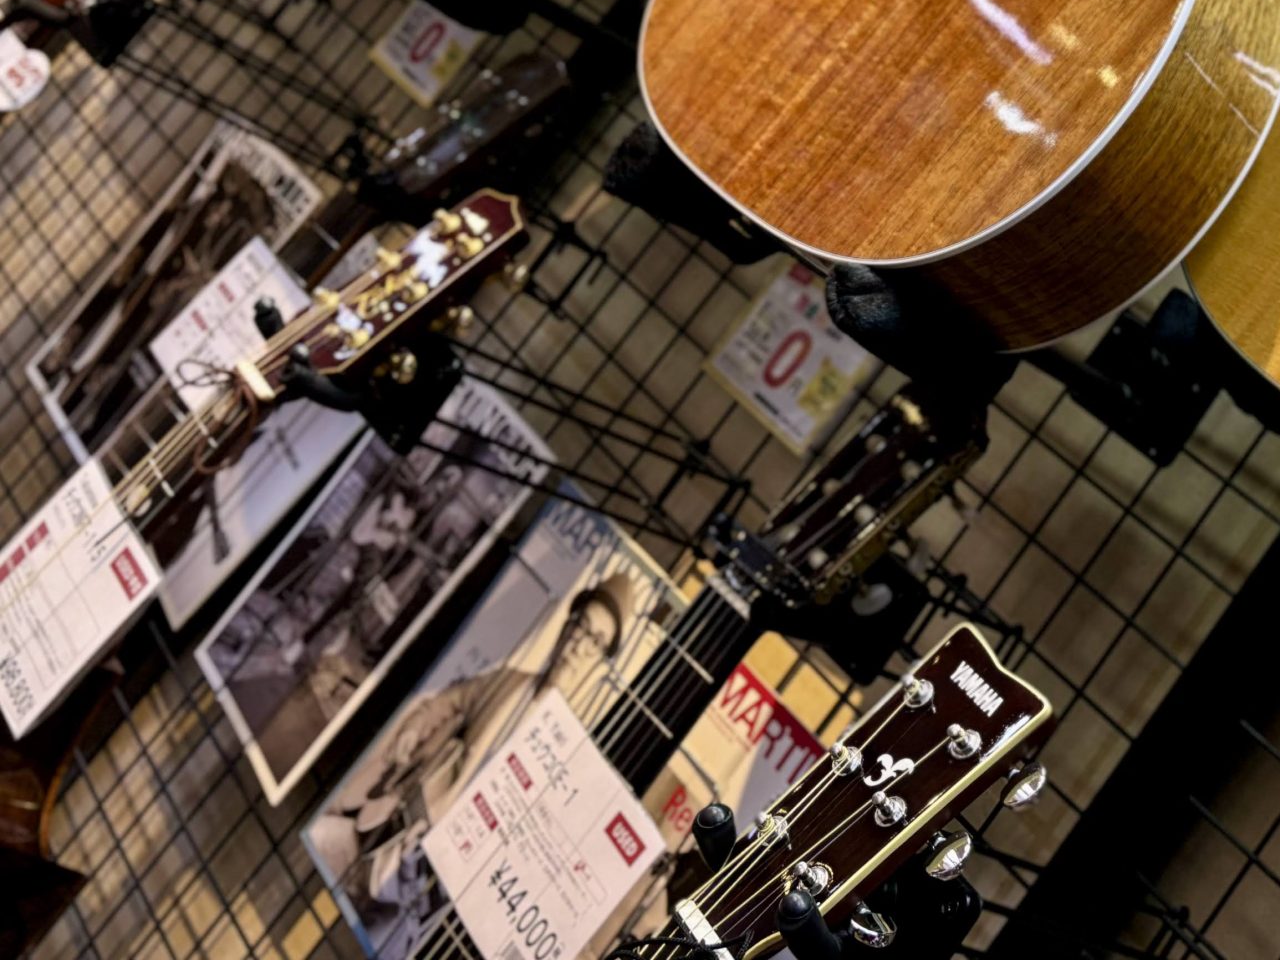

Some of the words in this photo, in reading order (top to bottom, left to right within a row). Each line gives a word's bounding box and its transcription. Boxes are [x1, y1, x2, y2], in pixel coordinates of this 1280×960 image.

[949, 660, 1004, 717] YAMAHA
[721, 672, 820, 786] MARTI
[661, 786, 694, 831] Re
[488, 858, 557, 955] ¥44,000
